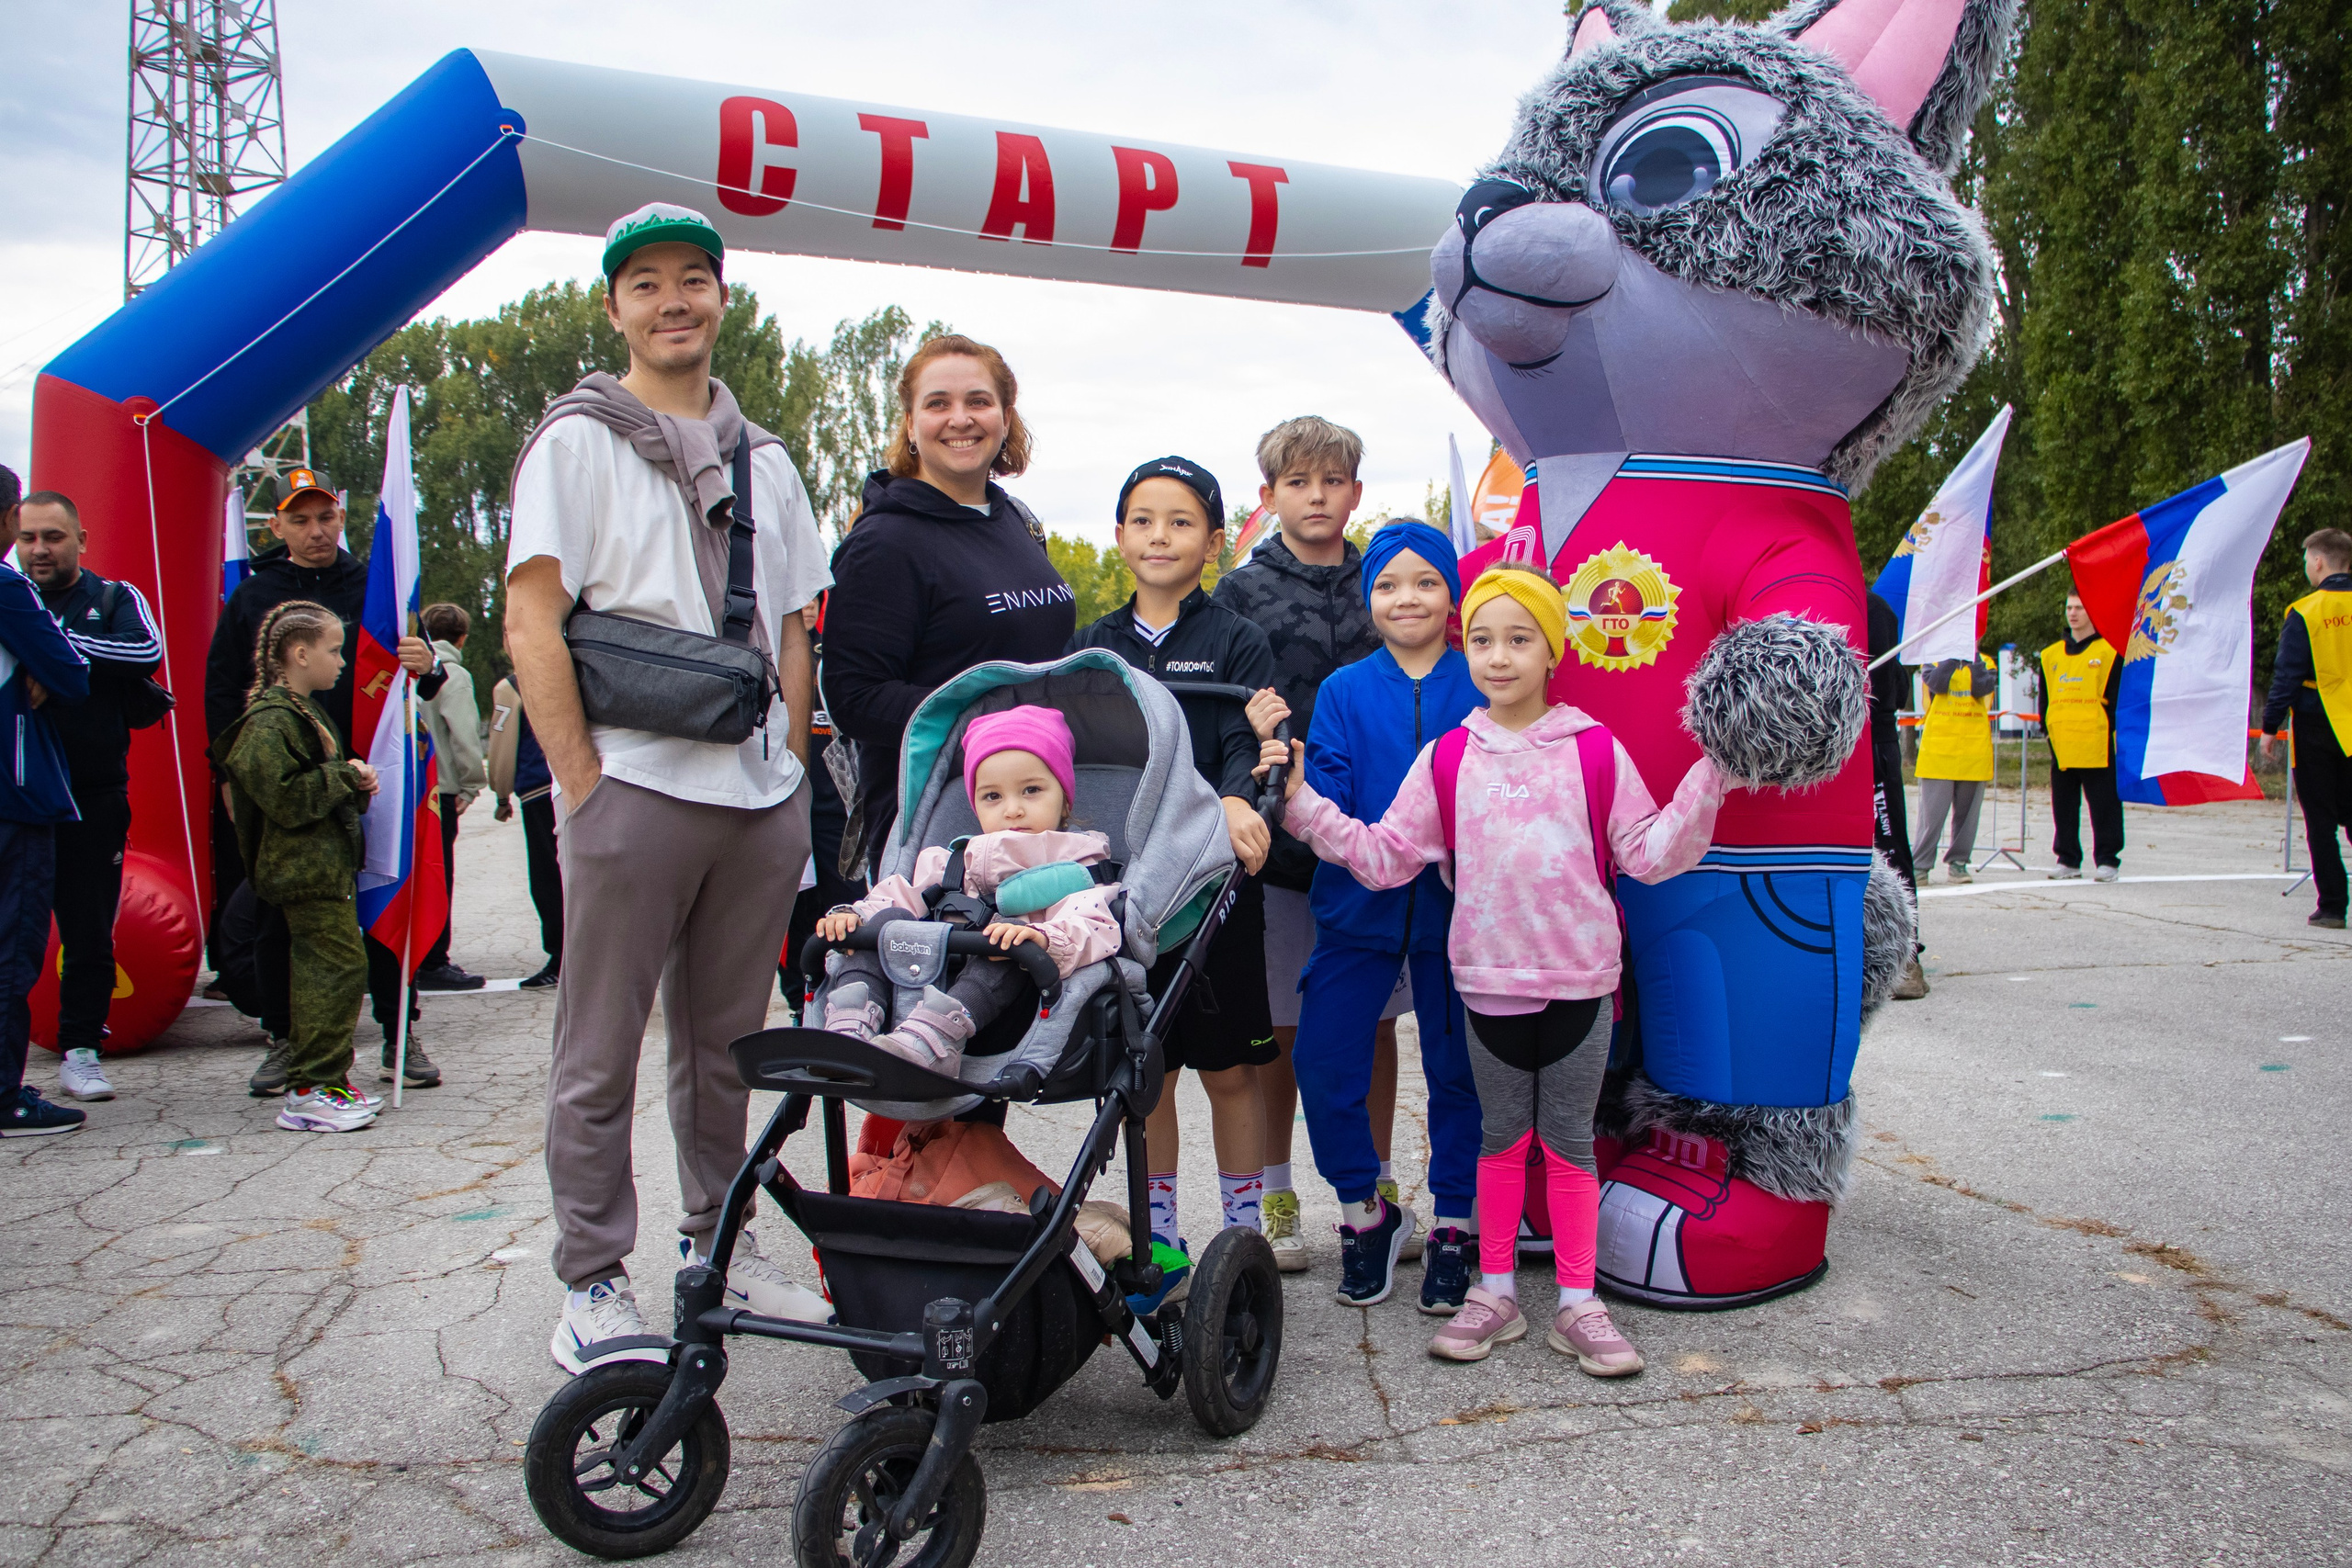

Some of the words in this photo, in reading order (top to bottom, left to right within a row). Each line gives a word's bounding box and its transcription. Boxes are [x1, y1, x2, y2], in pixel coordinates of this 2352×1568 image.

[717, 96, 1290, 268] СТАРТ
[985, 582, 1076, 614] ENAVAN
[1602, 618, 1630, 630] ГТО
[2324, 615, 2352, 629] РОС
[492, 704, 511, 732] 7
[1487, 783, 1530, 799] FILA
[1218, 889, 1236, 925] RIO
